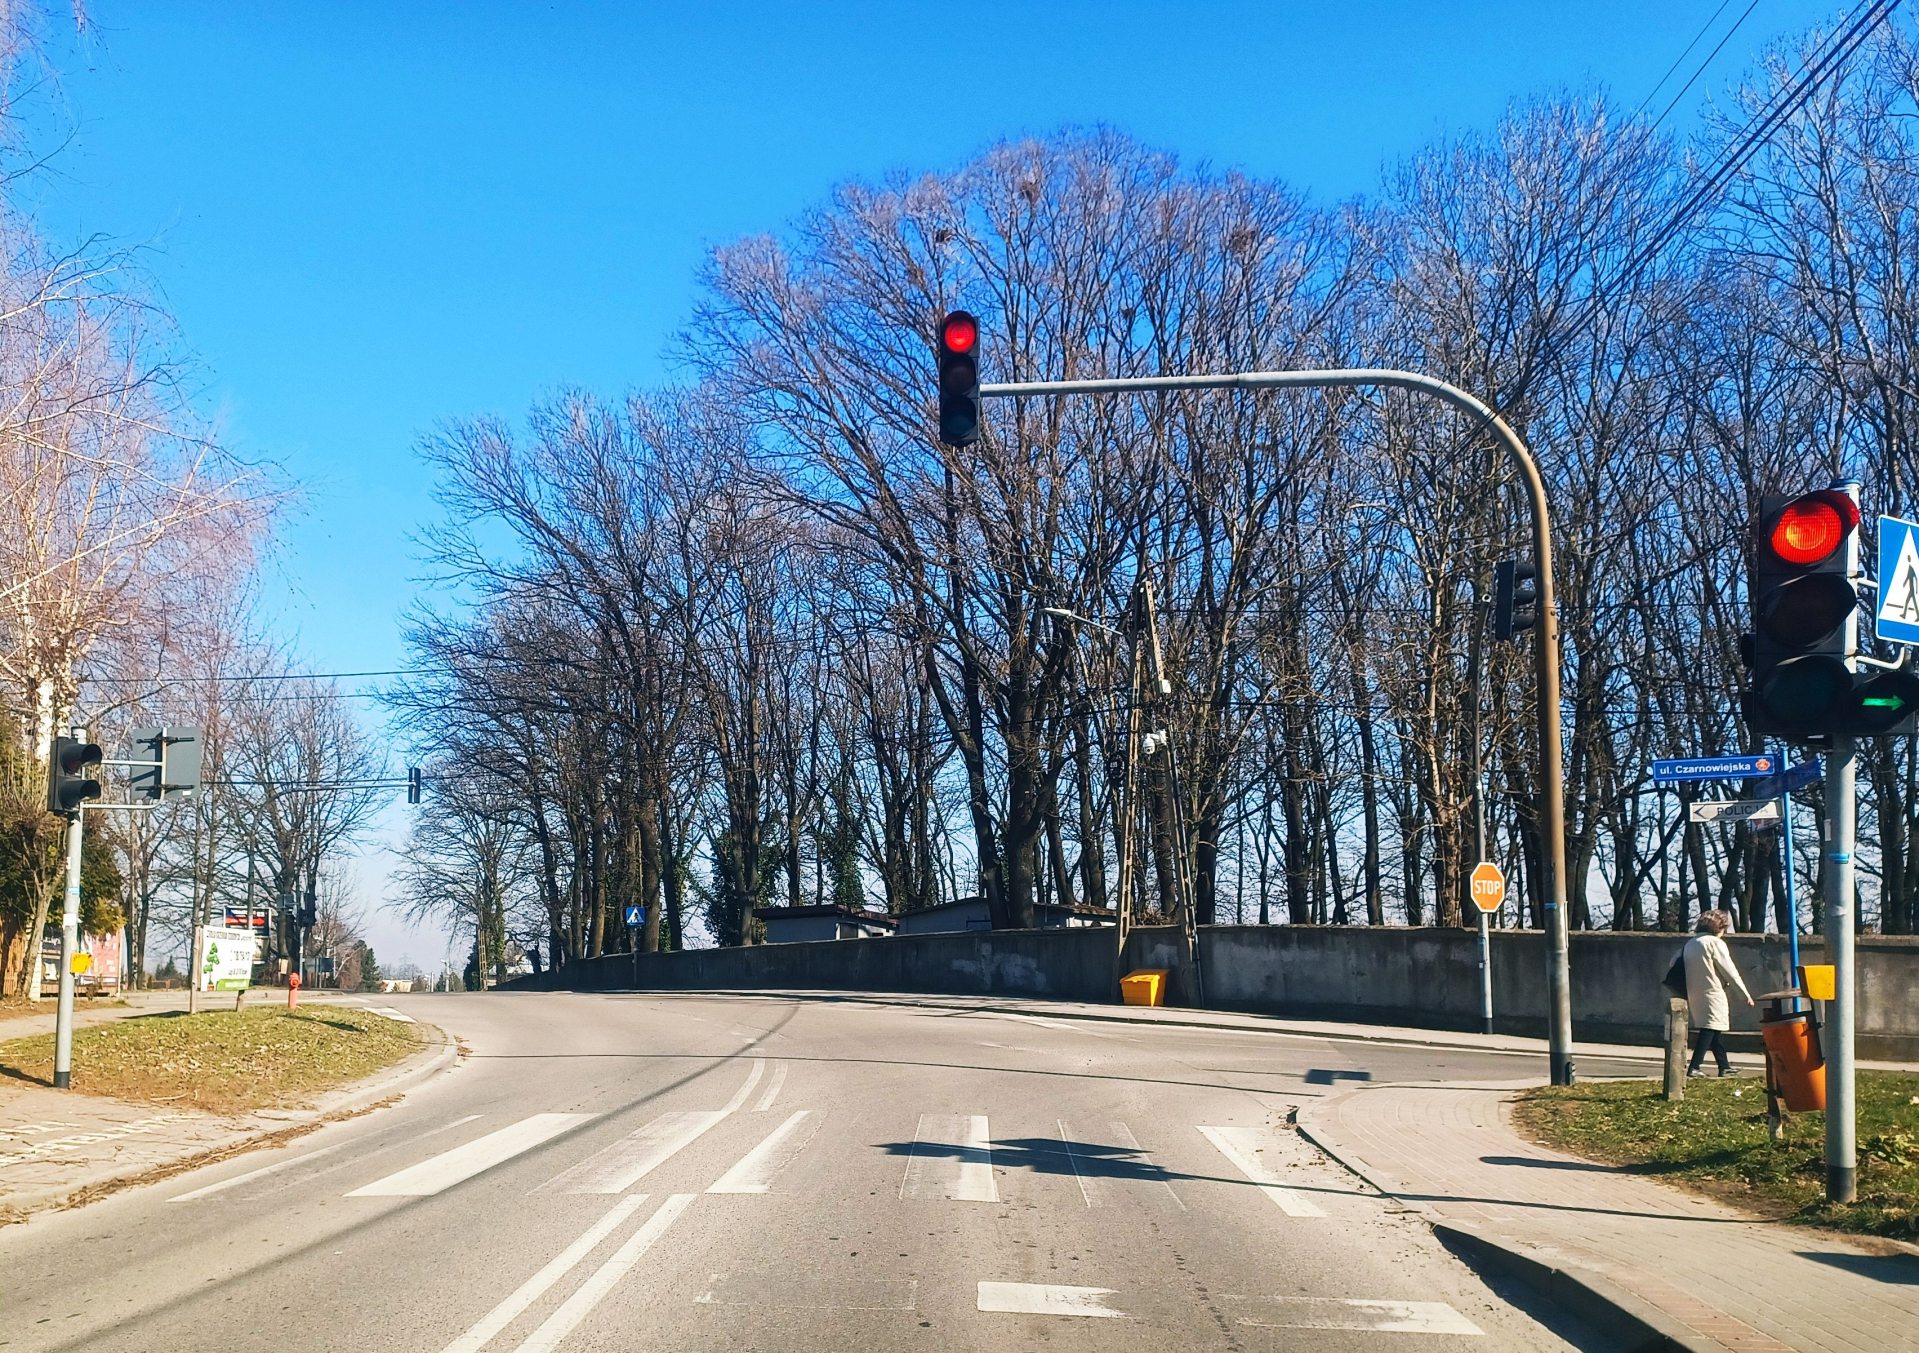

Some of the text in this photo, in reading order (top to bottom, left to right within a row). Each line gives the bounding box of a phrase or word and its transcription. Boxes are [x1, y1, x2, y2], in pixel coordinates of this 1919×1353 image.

[1660, 763, 1751, 775] ul. Czarnowiejska
[1474, 879, 1501, 895] STOP
